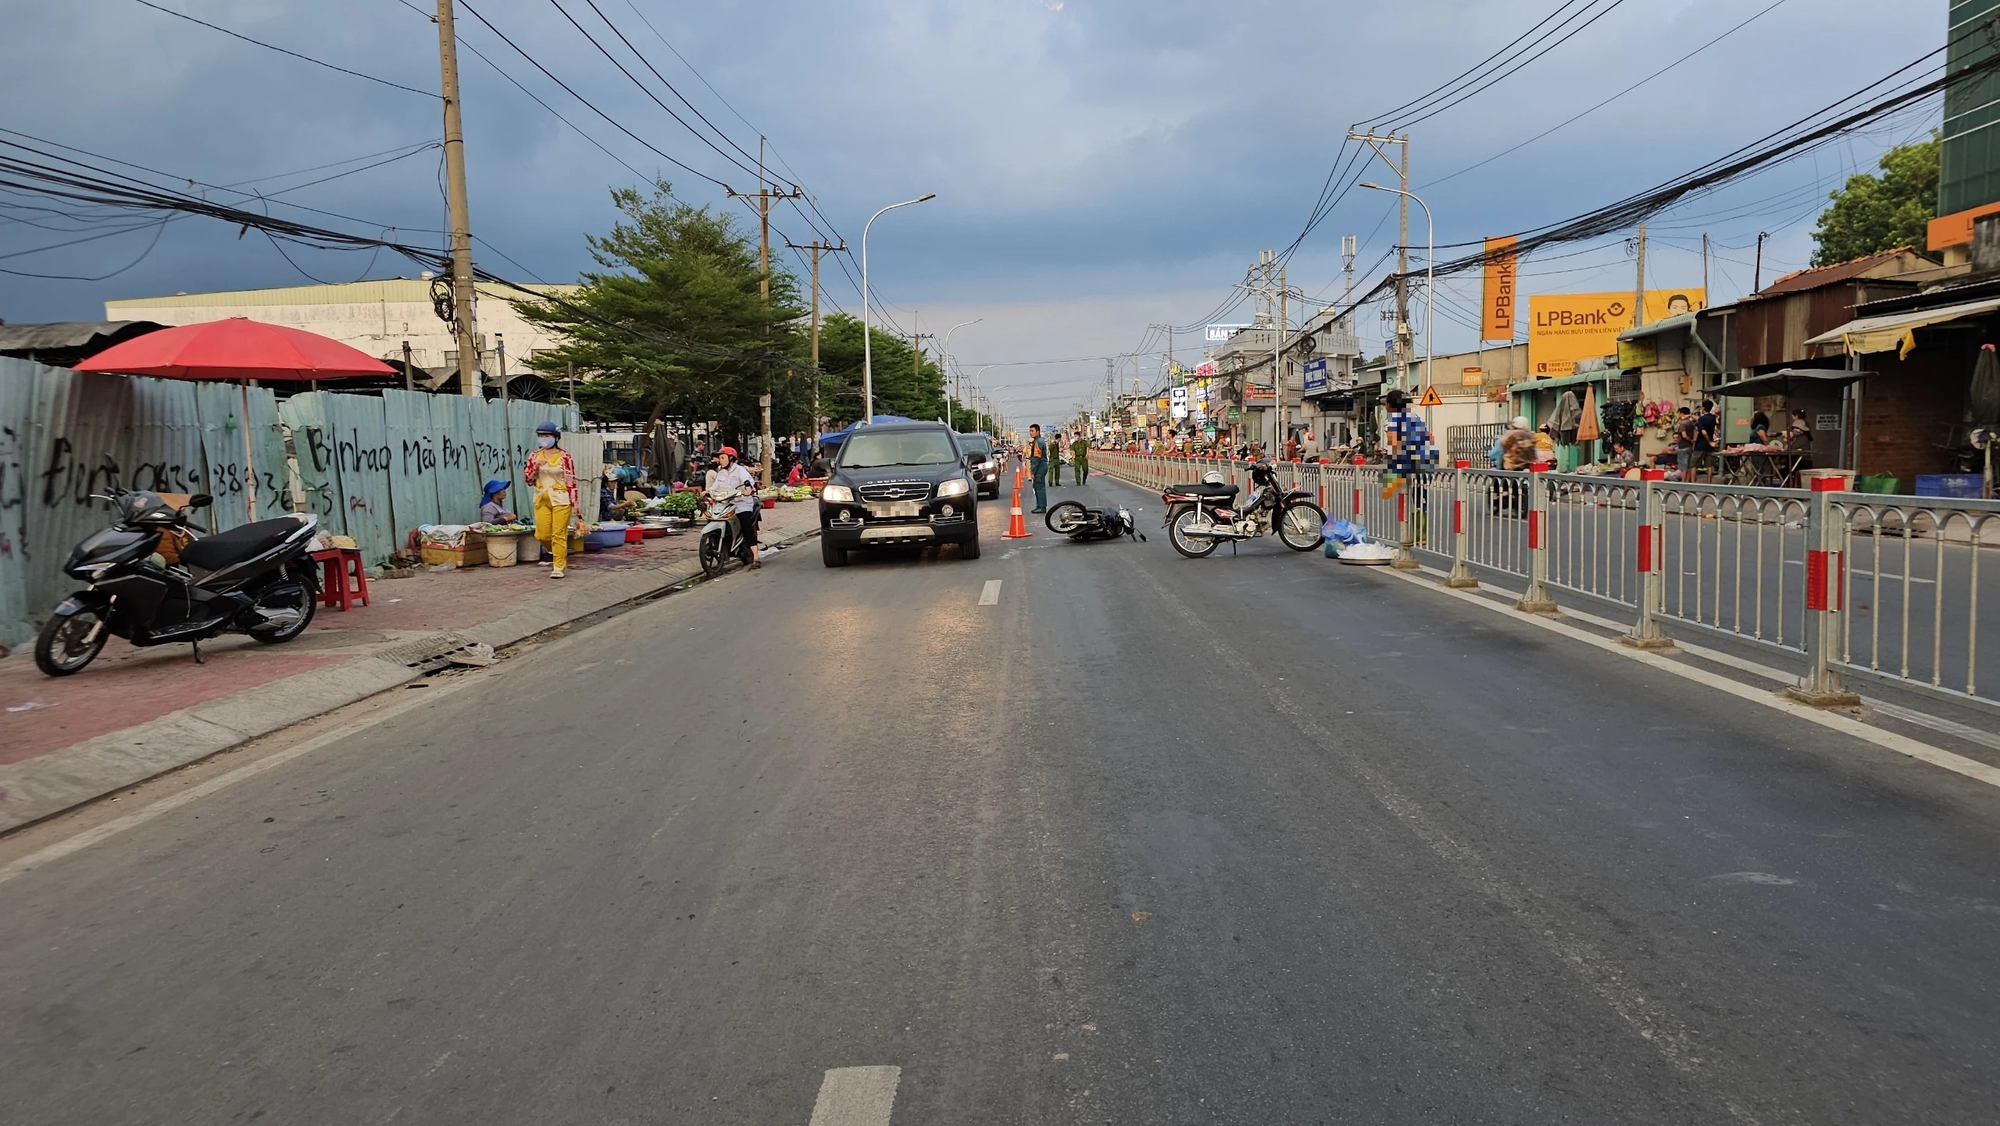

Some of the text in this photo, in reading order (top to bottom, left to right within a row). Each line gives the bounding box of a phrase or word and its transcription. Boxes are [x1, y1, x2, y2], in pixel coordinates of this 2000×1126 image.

[1495, 262, 1512, 329] LPBank
[1536, 309, 1607, 327] LPBank
[1464, 375, 1481, 383] ATM
